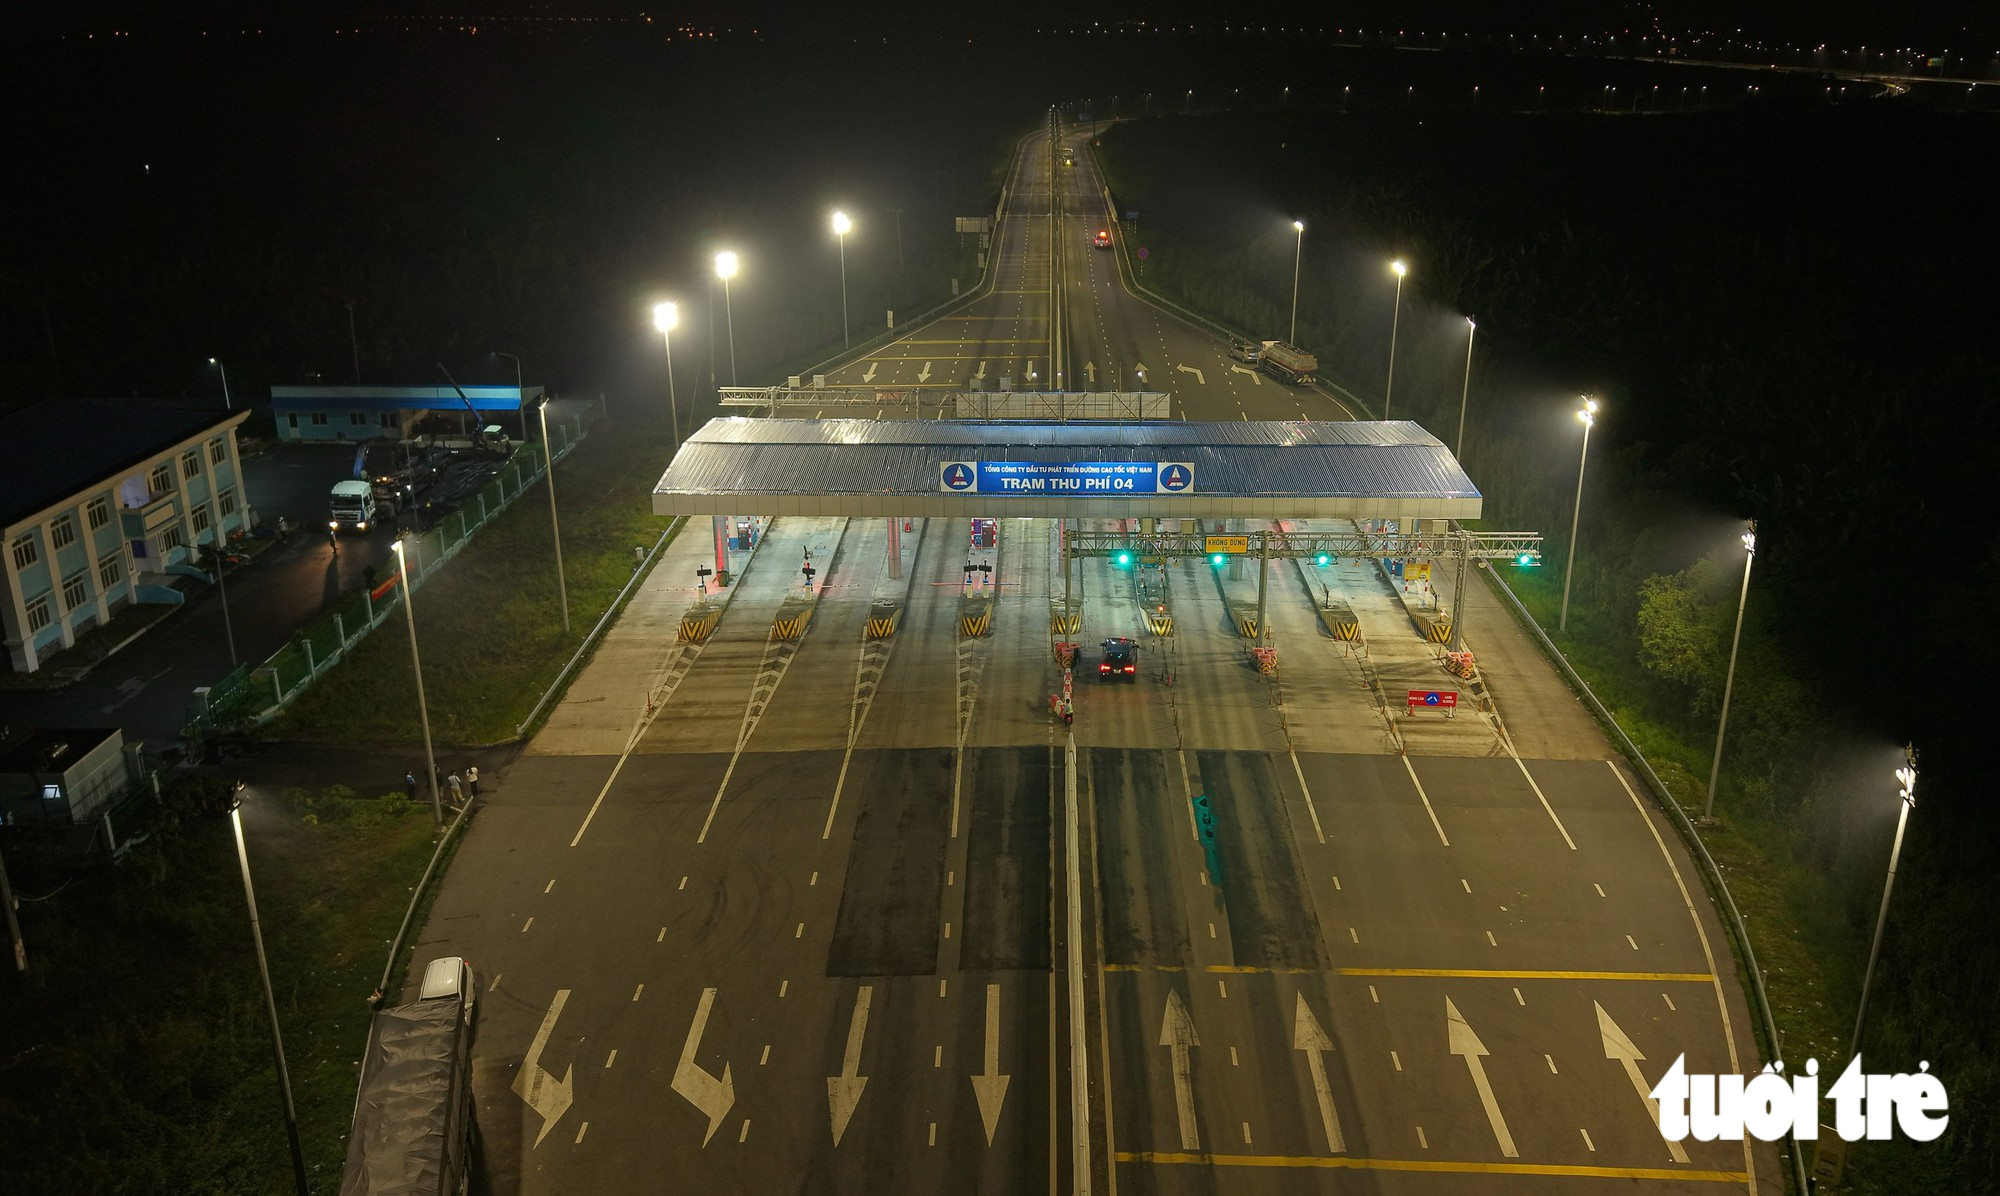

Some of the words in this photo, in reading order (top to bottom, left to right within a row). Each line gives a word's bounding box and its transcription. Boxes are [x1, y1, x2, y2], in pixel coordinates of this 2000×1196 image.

[1001, 465, 1017, 473] CÔNG
[1001, 478, 1045, 492] TRẠM
[1049, 478, 1080, 489] THU
[1085, 475, 1111, 489] PHÍ
[1113, 478, 1134, 490] 04
[1208, 538, 1228, 546] KHÔNG
